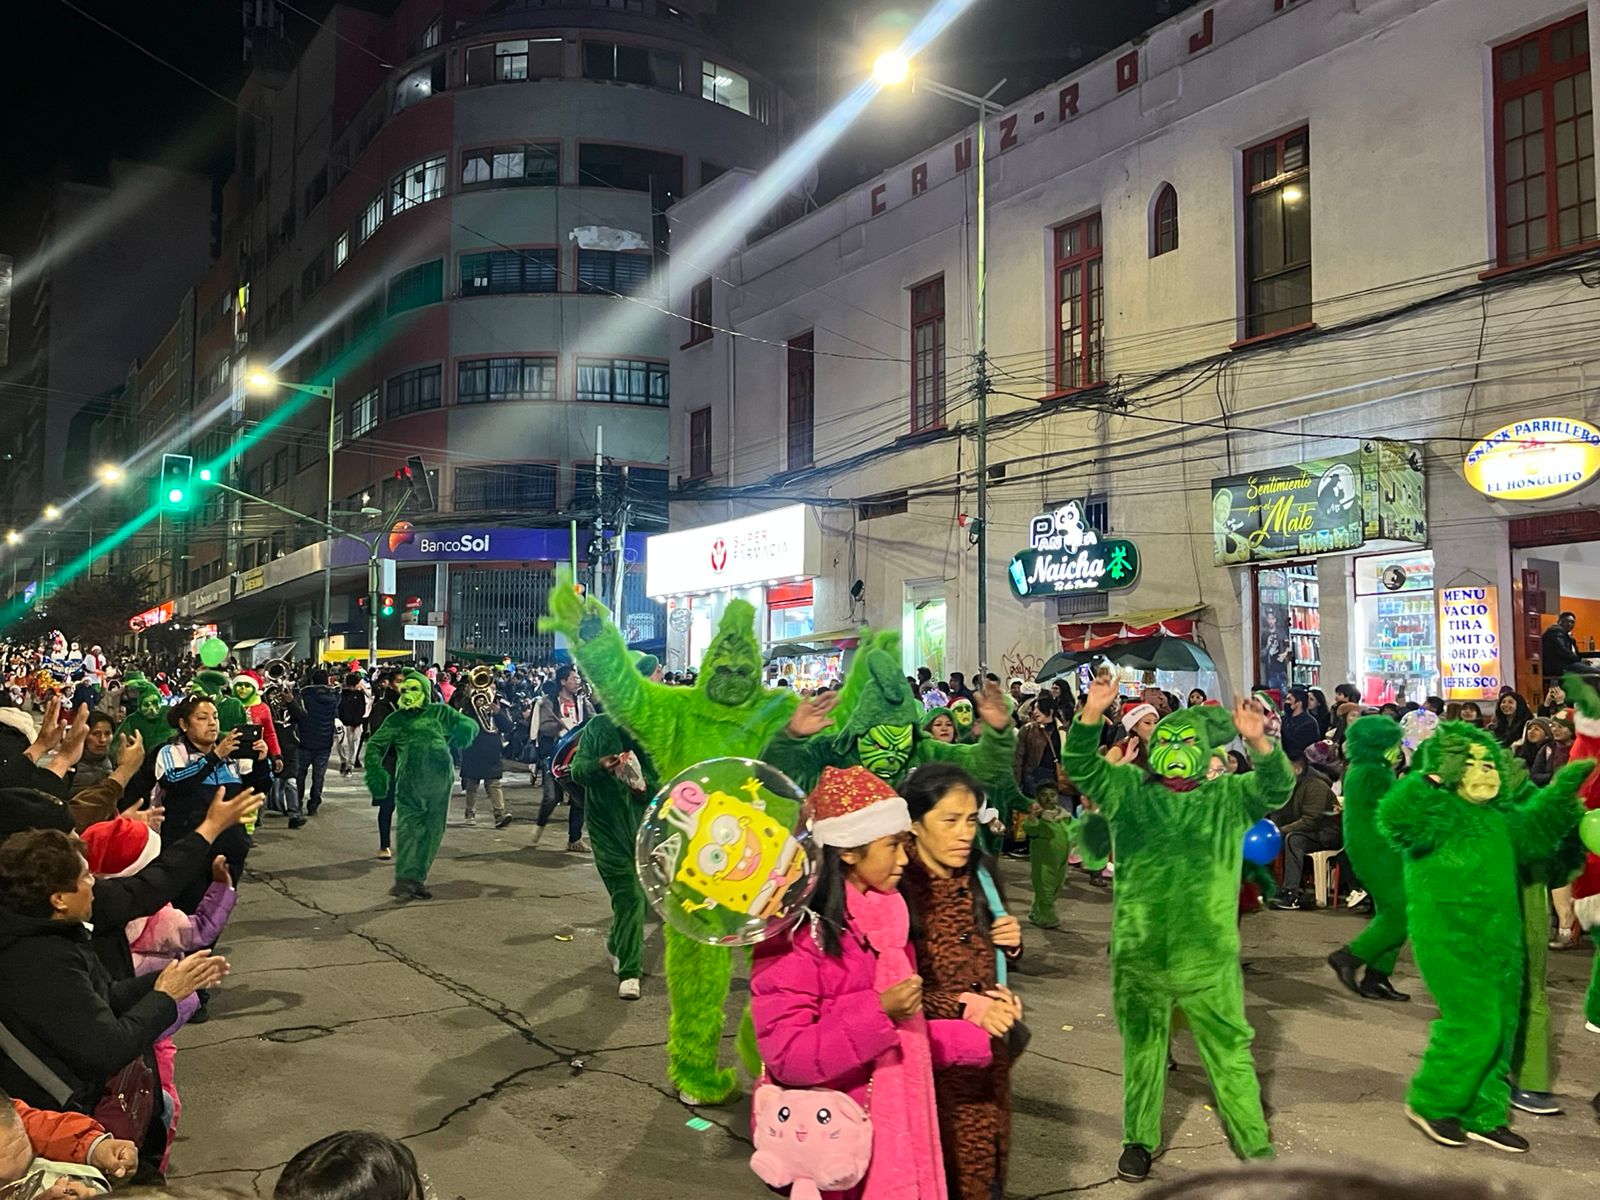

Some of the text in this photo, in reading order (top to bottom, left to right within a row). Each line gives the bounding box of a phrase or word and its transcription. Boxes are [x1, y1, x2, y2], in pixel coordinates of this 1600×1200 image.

[871, 0, 1299, 217] CRUZ-ROJ
[1468, 429, 1511, 466] SNACK
[1246, 471, 1312, 500] Sentimiento
[1487, 471, 1583, 493] EL HONGUITO
[1248, 494, 1316, 549] Mate
[420, 534, 490, 553] BancoSol
[1030, 514, 1098, 552] PANA
[1027, 551, 1107, 584] Naicha
[1443, 589, 1486, 601] MENU
[1443, 604, 1488, 617] VACIO
[1448, 619, 1482, 631] TIRA
[1444, 633, 1496, 645] OMITO
[1450, 662, 1481, 674] VINO
